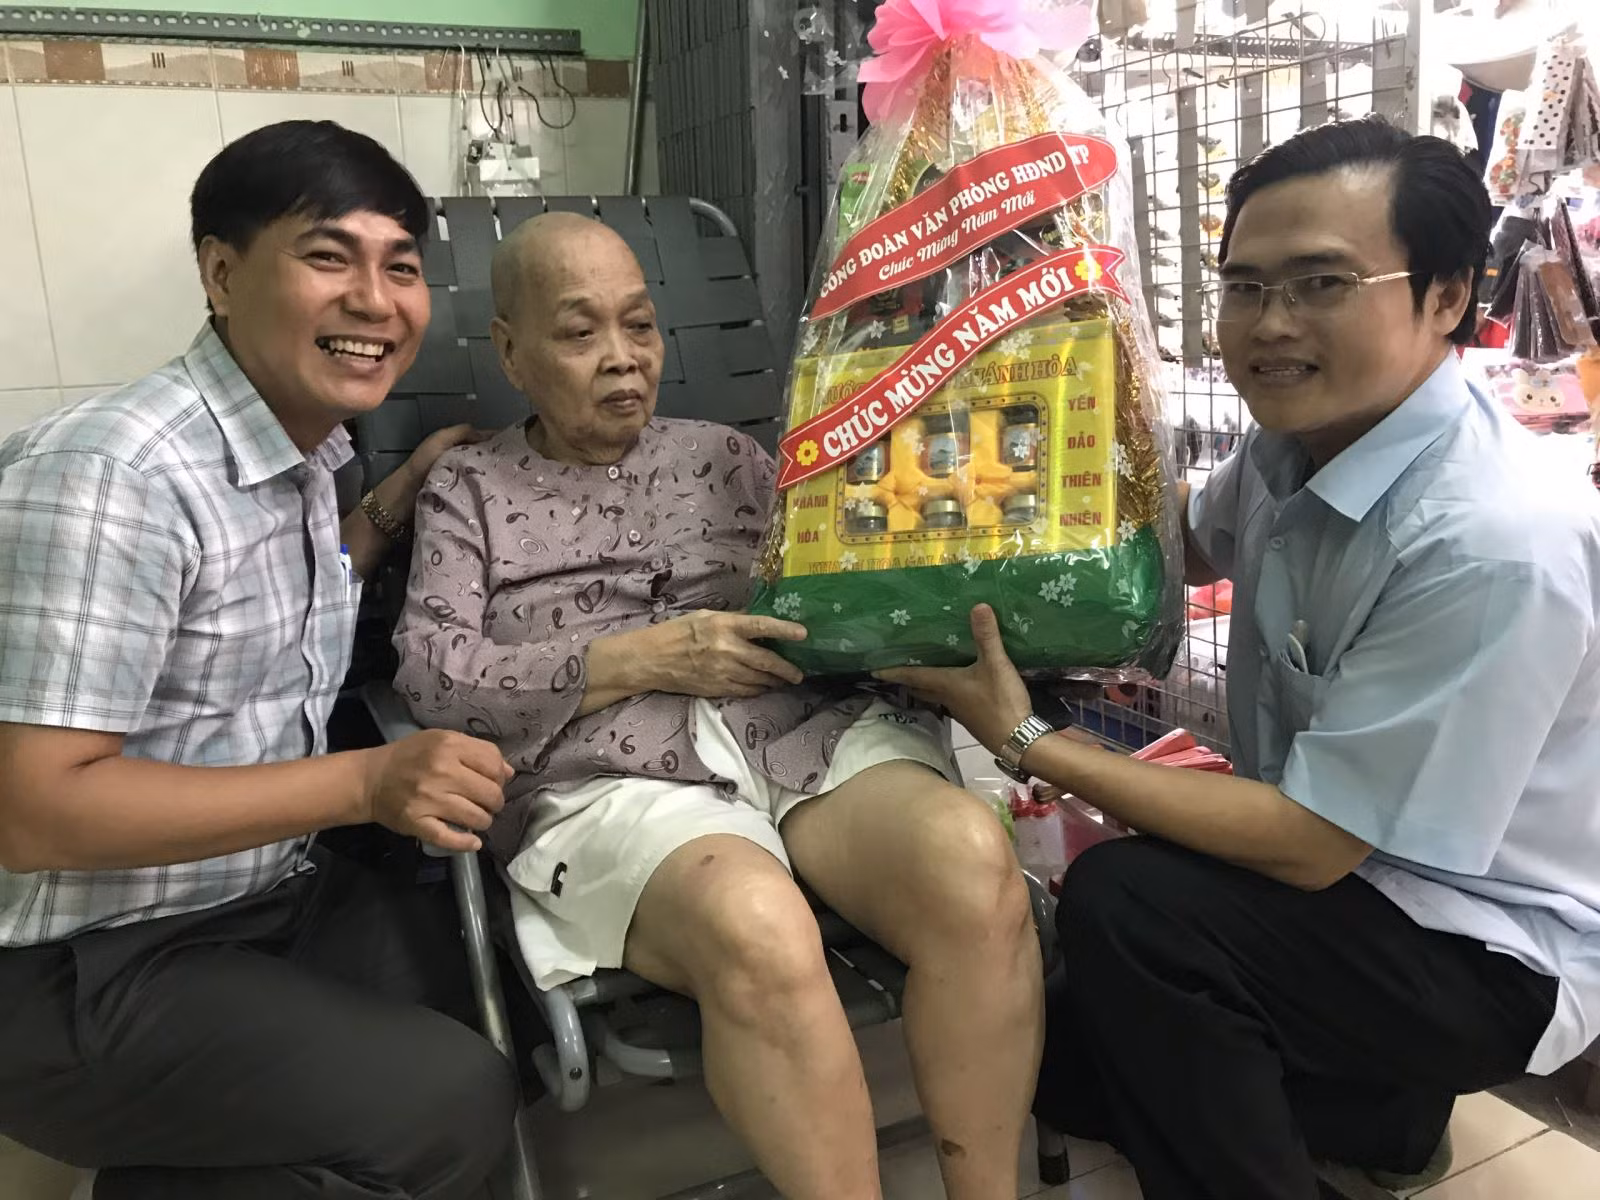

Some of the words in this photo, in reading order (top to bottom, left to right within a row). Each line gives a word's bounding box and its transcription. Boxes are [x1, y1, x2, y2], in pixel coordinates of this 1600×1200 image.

[820, 257, 857, 298] CÔNG
[858, 230, 909, 267] ĐOÀN
[910, 207, 949, 240] VĂN
[949, 171, 1010, 217] PHÒNG
[1010, 151, 1067, 184] HĐND
[1066, 144, 1090, 165] TP
[878, 256, 914, 280] Chúc
[917, 229, 959, 262] Mừng
[961, 208, 998, 234] Năm
[1001, 190, 1036, 215] Mới
[823, 400, 888, 457] CHÚC
[884, 342, 956, 414] MỪNG
[952, 296, 1019, 352] NĂM
[1016, 267, 1075, 312] MỚI
[1032, 353, 1078, 381] HÒA
[1067, 393, 1096, 412] YẾN
[1067, 431, 1096, 450] ĐẢO
[1061, 470, 1102, 489] THIÊN
[1059, 510, 1102, 528] NHIÊN
